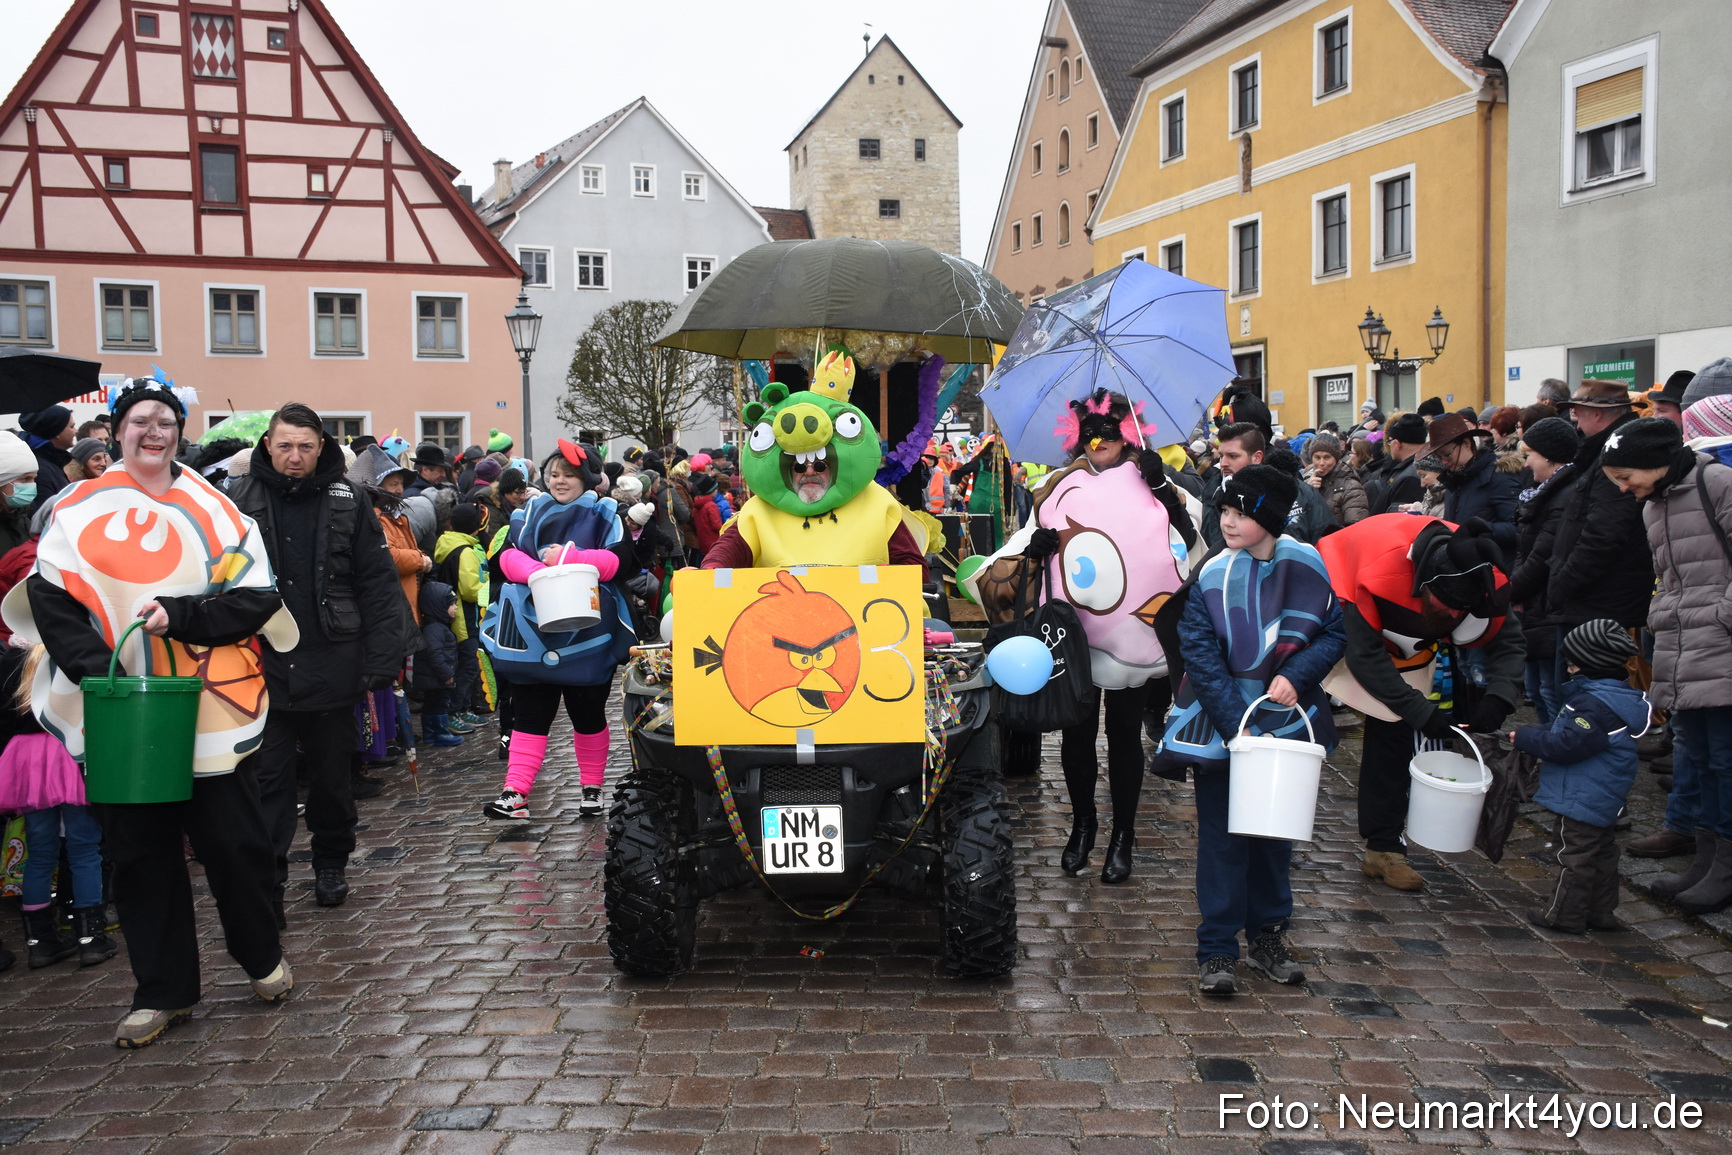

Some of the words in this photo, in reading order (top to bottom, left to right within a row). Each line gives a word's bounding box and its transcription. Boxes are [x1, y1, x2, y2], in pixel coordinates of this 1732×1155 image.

[1584, 365, 1594, 374] ZU
[1596, 361, 1634, 372] VERMIETEN
[1327, 380, 1347, 393] BW
[862, 598, 916, 703] 3
[780, 812, 820, 838] NM
[771, 842, 810, 868] UR
[817, 841, 835, 867] 8
